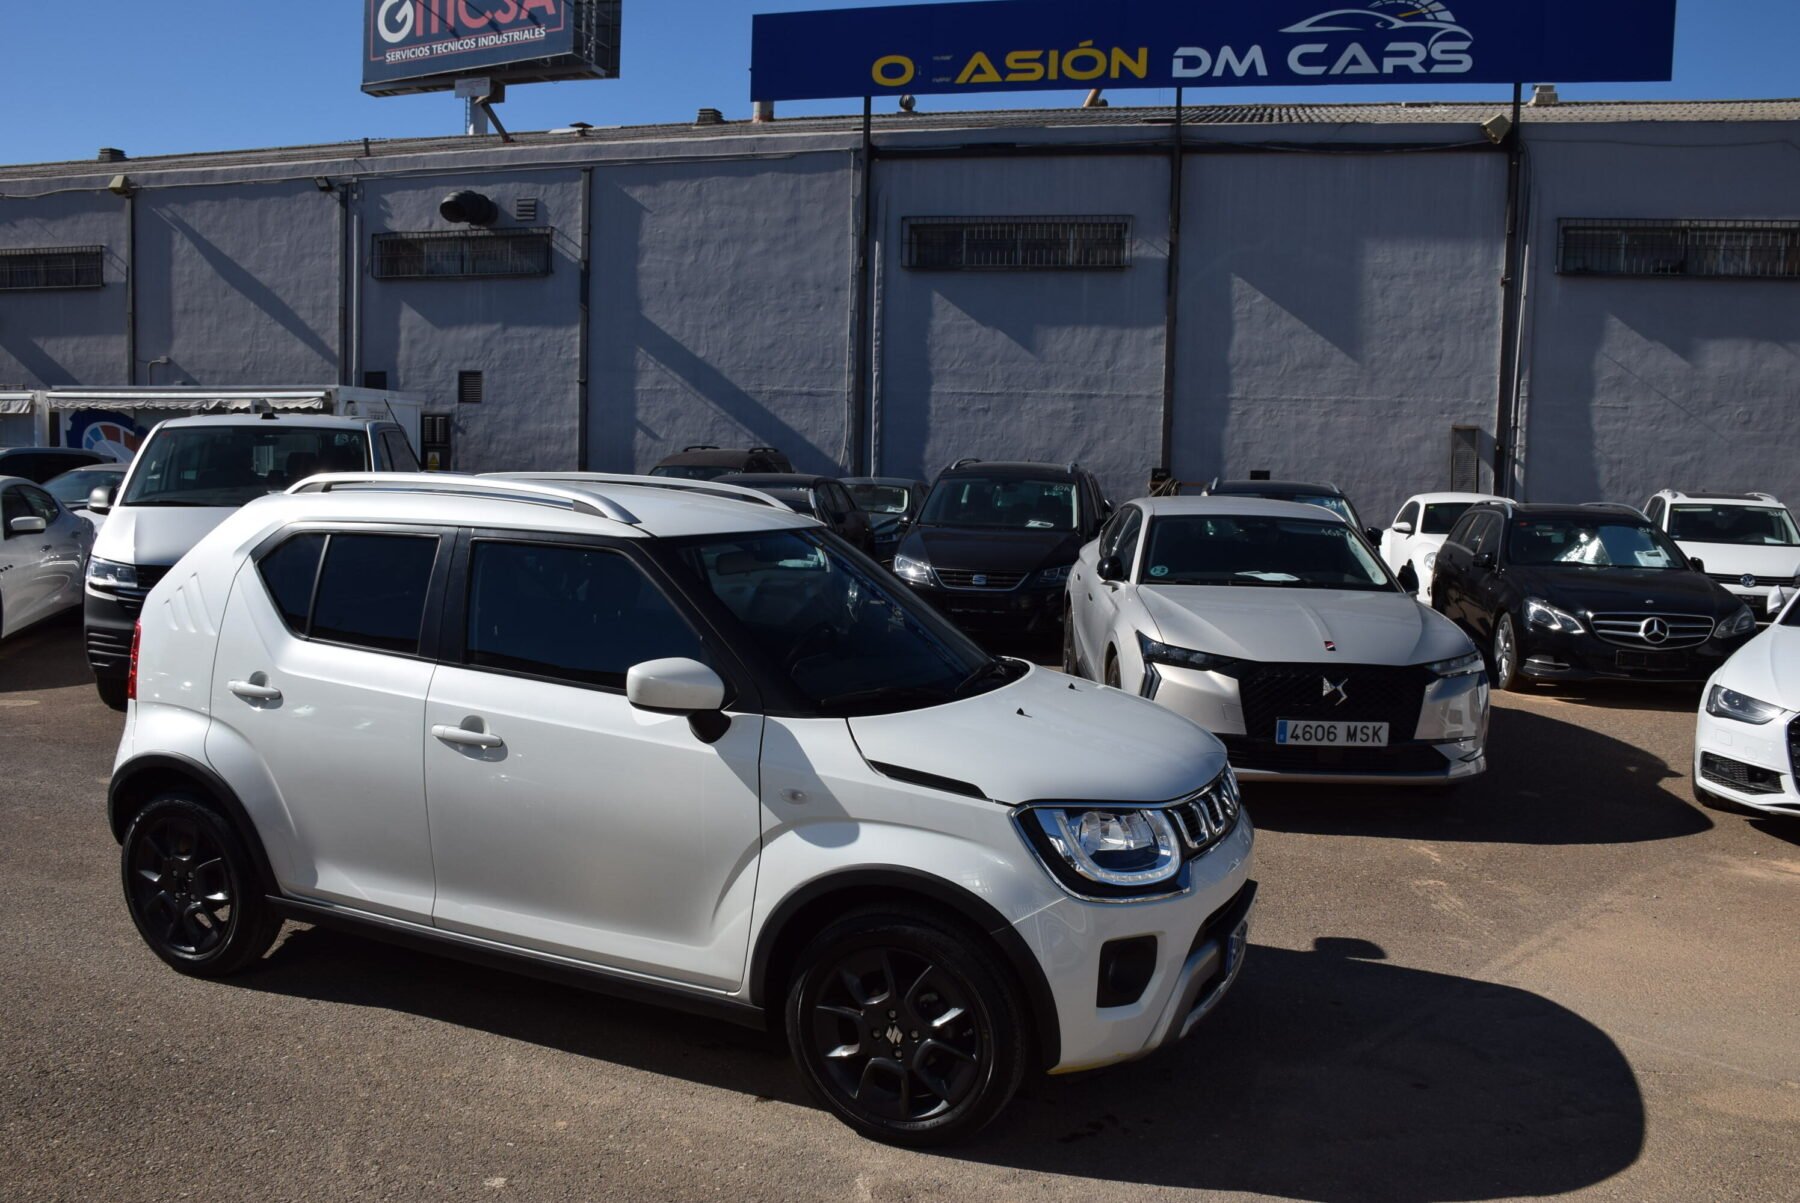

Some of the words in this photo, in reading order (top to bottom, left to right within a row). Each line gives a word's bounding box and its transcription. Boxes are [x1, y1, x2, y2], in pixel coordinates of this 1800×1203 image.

[385, 47, 430, 63] SERVICIOS
[432, 38, 476, 54] TECNICOS
[478, 27, 546, 48] INDUSTRIALES
[871, 39, 1148, 87] OASIÓN
[1172, 44, 1268, 78] DM
[1287, 41, 1474, 76] CARS
[1290, 724, 1338, 742] 4606
[1346, 725, 1383, 743] MSK
